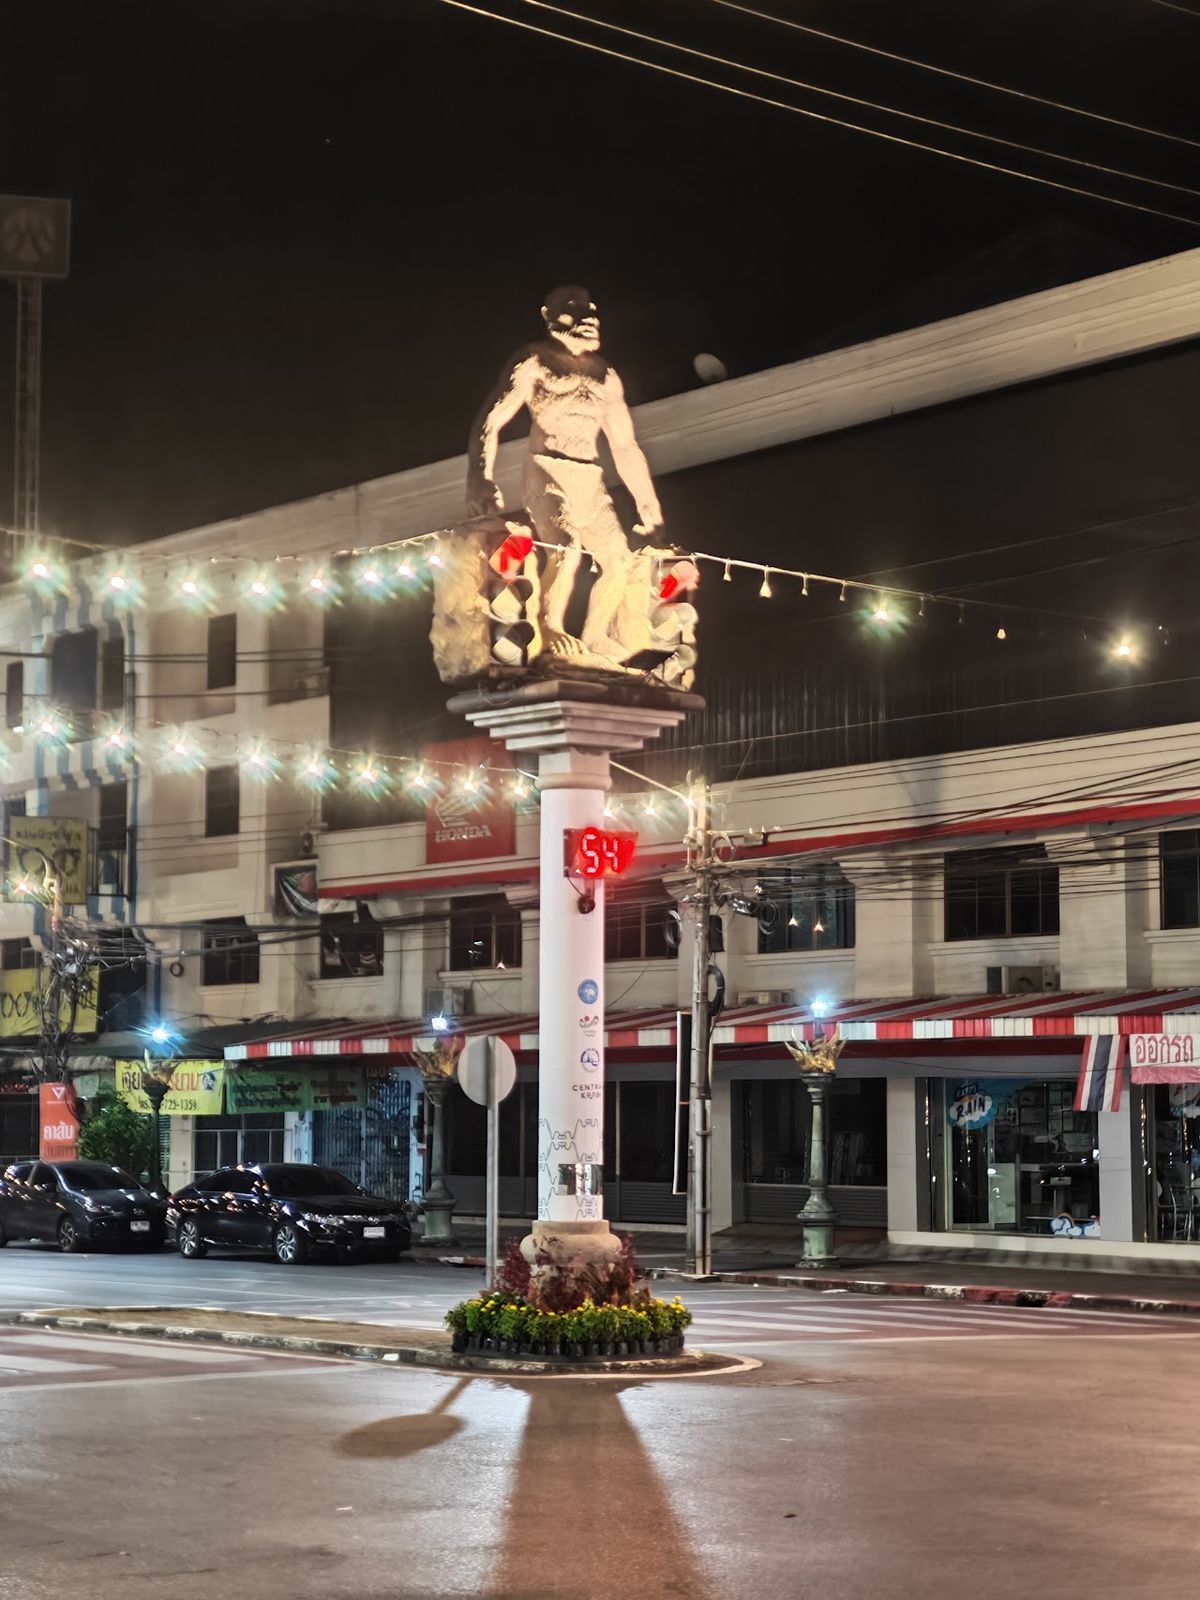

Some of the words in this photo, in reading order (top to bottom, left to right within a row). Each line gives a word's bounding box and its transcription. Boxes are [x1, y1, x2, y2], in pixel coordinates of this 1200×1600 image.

[435, 825, 492, 842] HONDA
[581, 833, 618, 873] 54
[1135, 1035, 1193, 1064] ออกรถ
